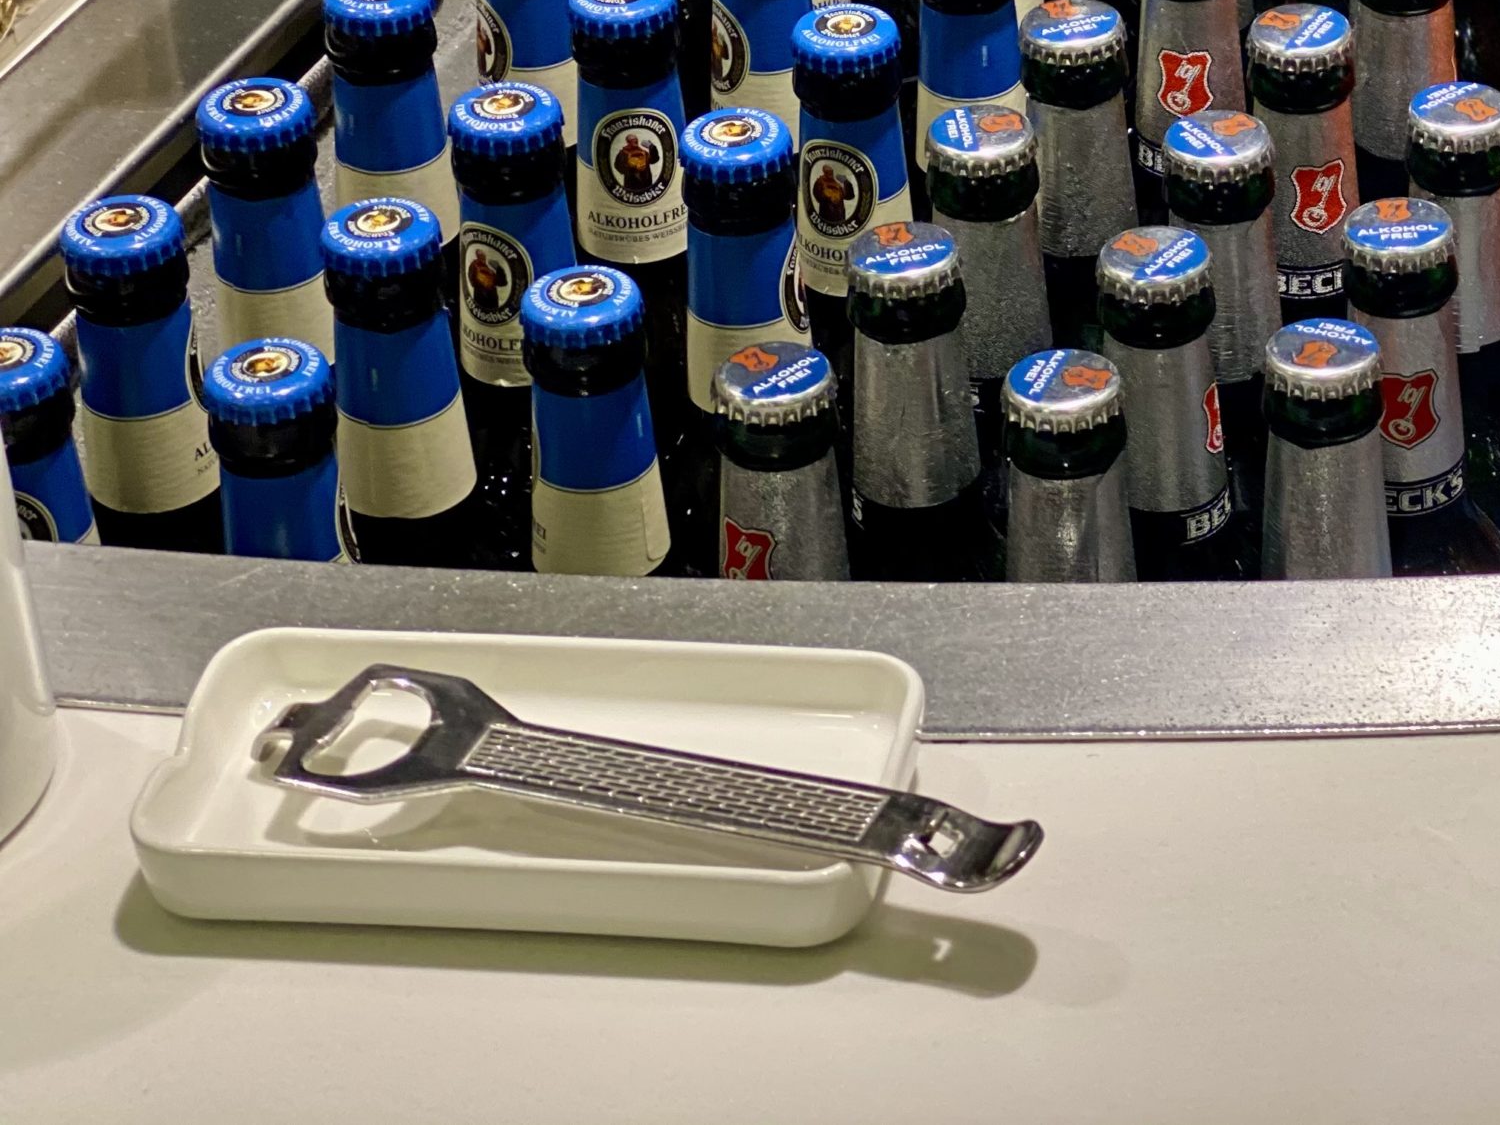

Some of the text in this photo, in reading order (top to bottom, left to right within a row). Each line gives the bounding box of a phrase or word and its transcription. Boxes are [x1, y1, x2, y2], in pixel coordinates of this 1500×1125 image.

[1042, 13, 1111, 35] ALKOHOL
[1064, 23, 1097, 35] FREI
[1294, 10, 1332, 46] ALKOHOL
[1313, 21, 1334, 40] FREI
[801, 29, 881, 48] ALKOHOLFREI
[1419, 83, 1479, 111] ALKOHOL
[1426, 85, 1457, 100] FREI
[602, 115, 666, 141] Franziskaner
[946, 119, 959, 140] FREI
[955, 108, 973, 148] ALKOHOL
[1178, 119, 1224, 154] ALKOHOL
[1179, 131, 1205, 149] FREI
[612, 181, 666, 203] Weissbier
[588, 203, 687, 229] ALKOHOLFRE
[810, 211, 859, 237] Weissbier
[327, 221, 402, 249] ALKOHOLFREI
[1357, 225, 1439, 237] ALKOHOL
[865, 243, 946, 265] ALKOHOL
[890, 253, 928, 266] FREI
[1144, 236, 1196, 275] ALKOHOL
[1166, 249, 1194, 269] FREI
[1294, 324, 1372, 345] ALKOHOL
[1320, 322, 1356, 335] FREI
[211, 355, 272, 394] ALKOHOLFREI
[752, 355, 820, 394] ALKOHOL
[777, 369, 812, 389] FREI
[1024, 359, 1046, 382] FREI
[1029, 350, 1065, 395] ALKOHOL
[1385, 468, 1464, 512] ECK'S
